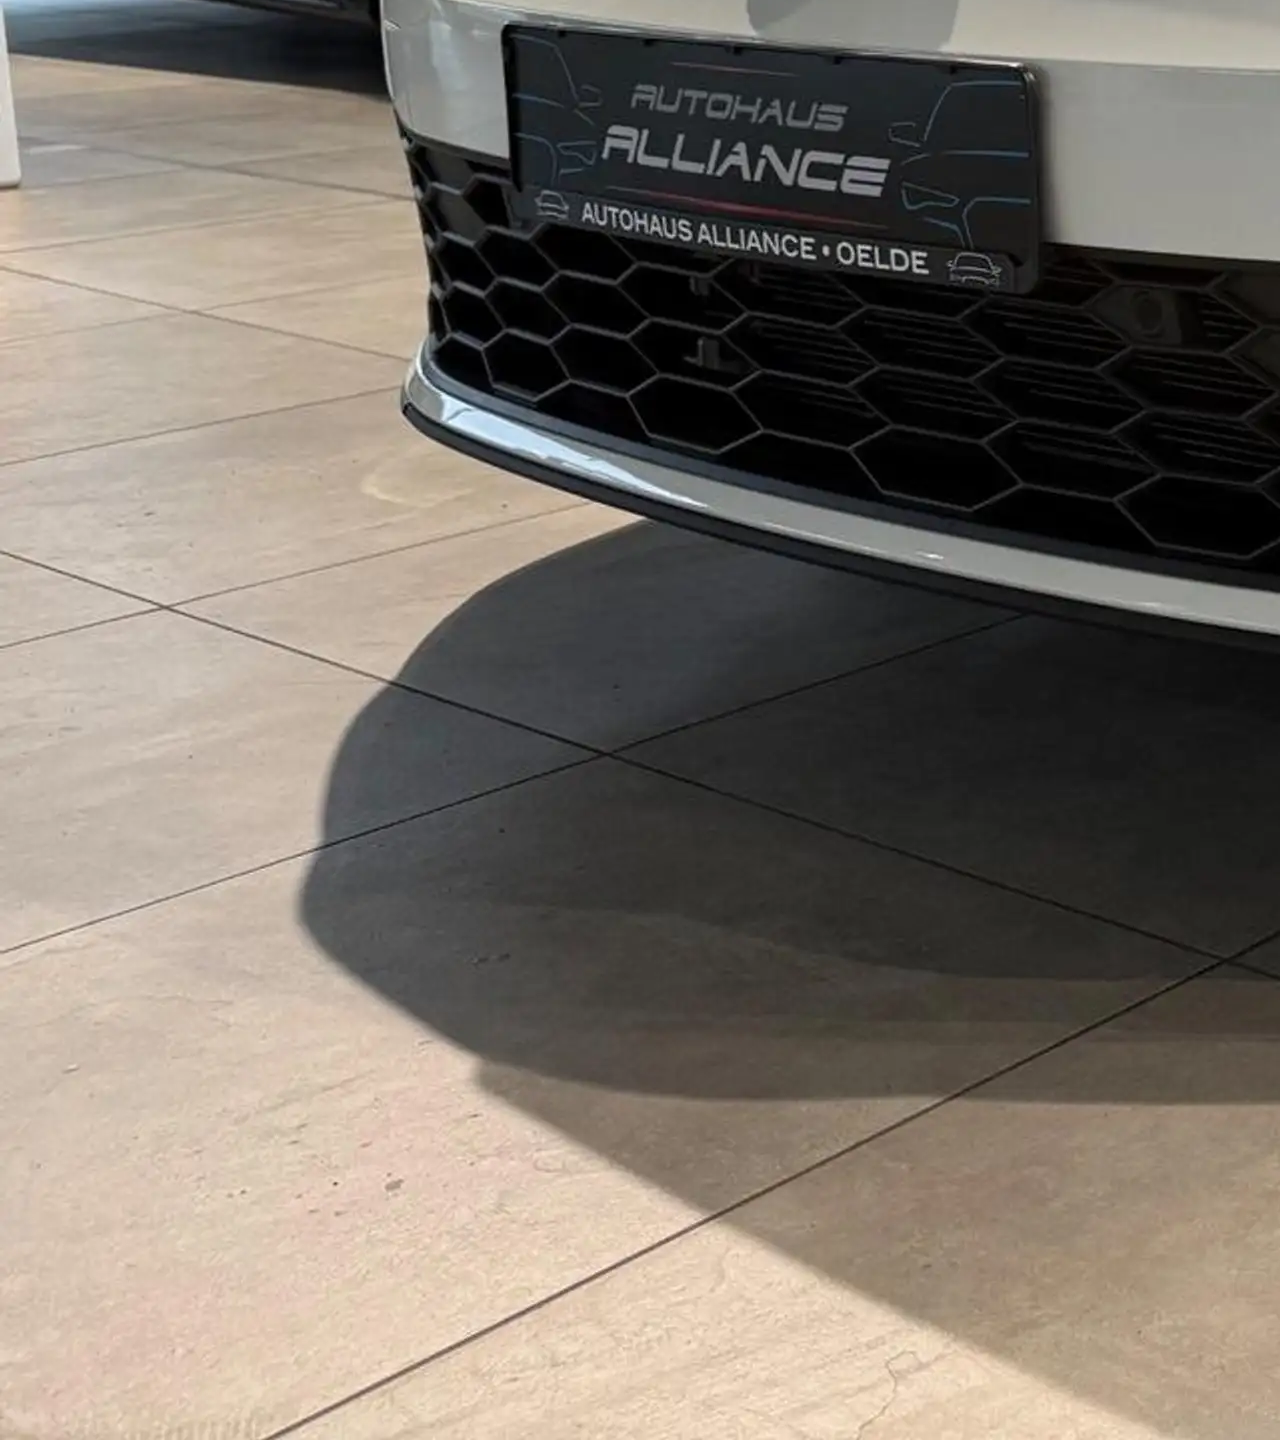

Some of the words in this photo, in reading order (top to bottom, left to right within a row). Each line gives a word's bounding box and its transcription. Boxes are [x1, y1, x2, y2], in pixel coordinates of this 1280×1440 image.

[630, 83, 848, 132] AUTOHAUS
[602, 125, 891, 197] ALLIANCE
[582, 202, 693, 242] AUTOHAUS
[697, 222, 817, 260] ALLIANCE
[836, 241, 930, 276] OELDE
